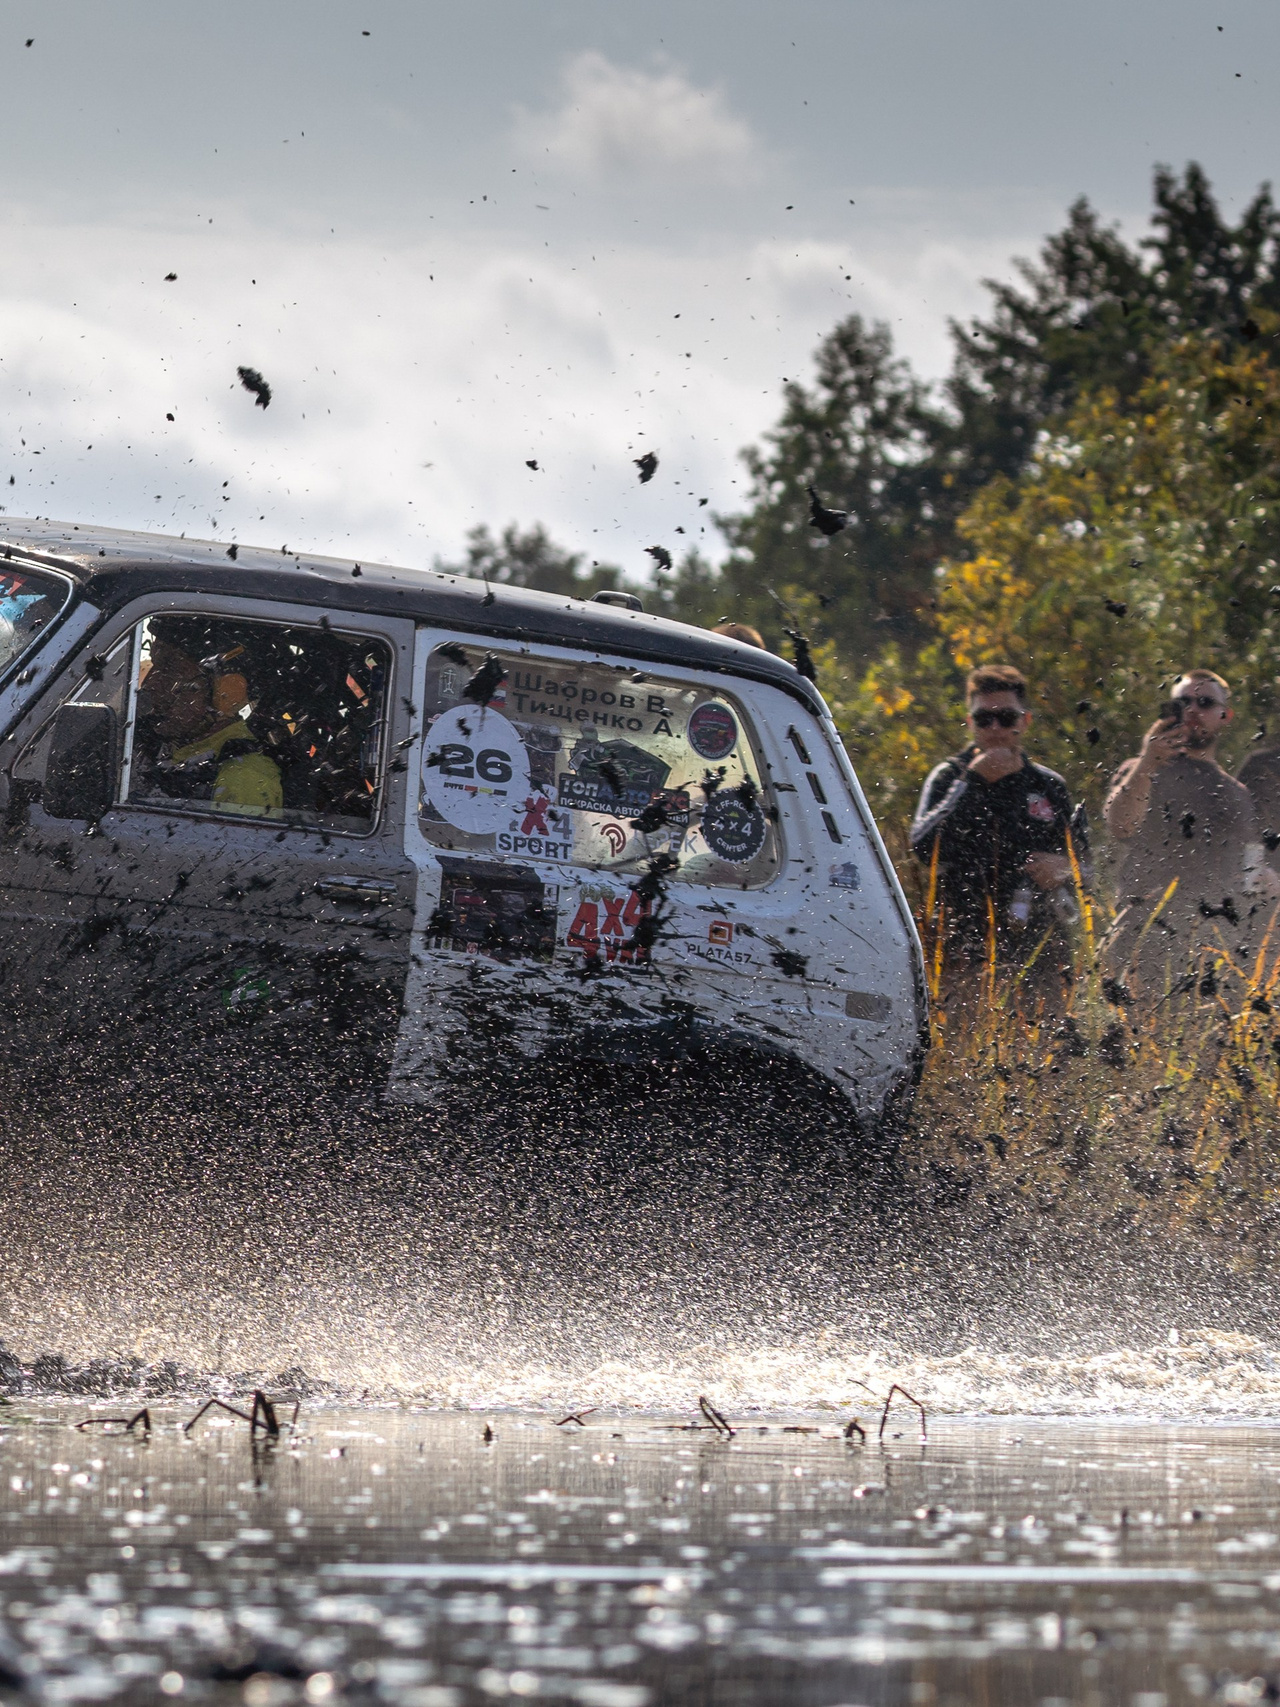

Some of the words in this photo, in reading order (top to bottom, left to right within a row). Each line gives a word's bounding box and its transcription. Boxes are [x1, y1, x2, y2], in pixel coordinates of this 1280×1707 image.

[515, 672, 635, 709] Шабров
[512, 692, 643, 731] Тищенко
[653, 718, 681, 739] А.
[438, 743, 513, 784] 26
[498, 833, 573, 859] SPORT
[716, 837, 748, 852] CENTER
[687, 943, 752, 963] PLATA57
